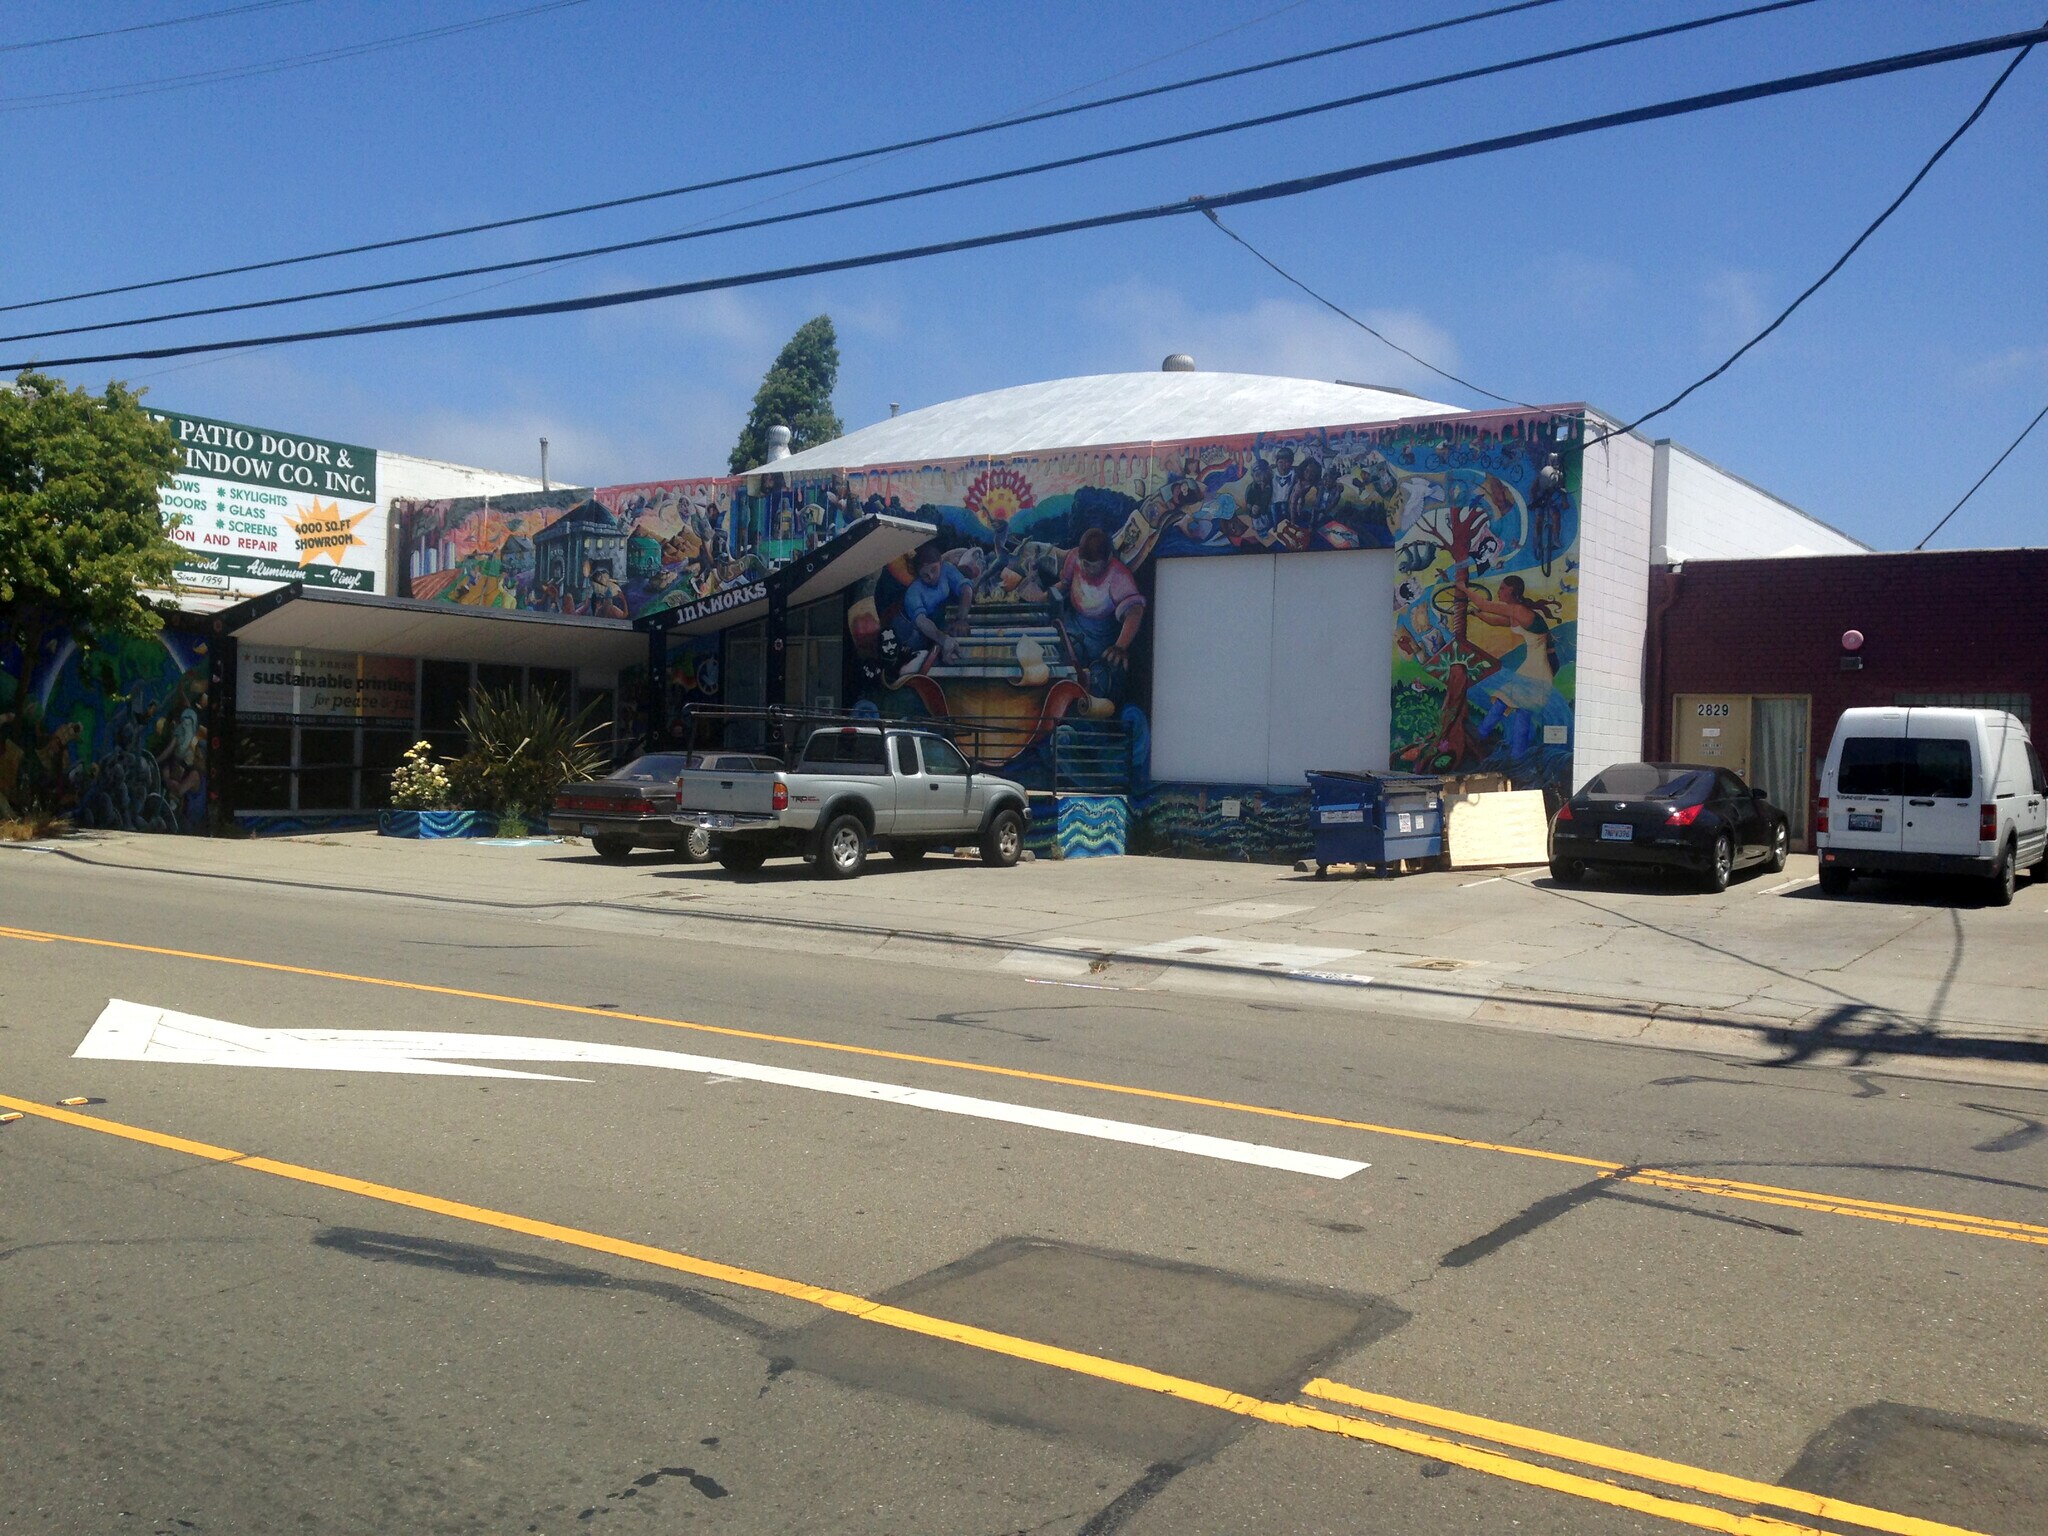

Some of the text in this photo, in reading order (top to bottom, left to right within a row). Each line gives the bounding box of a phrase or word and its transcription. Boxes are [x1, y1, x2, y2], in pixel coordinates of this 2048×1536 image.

[179, 419, 254, 451] PATIO
[259, 434, 331, 465] DOOR
[336, 448, 354, 469] &
[172, 447, 371, 495] INDOW CO. INC.
[164, 494, 207, 511] DOORS
[229, 487, 288, 507] SKYLIGHTS
[229, 504, 266, 519] GLASS
[228, 519, 278, 537] SCREENS
[203, 532, 230, 547] AND
[238, 537, 278, 552] REPAIR
[294, 533, 354, 551] SHOWROOM
[175, 571, 223, 586] Since 1959
[246, 558, 307, 580] Aluminum
[329, 567, 361, 590] Vinyl
[254, 654, 316, 668] INKWORKS
[252, 668, 352, 690] sustainable
[310, 692, 329, 709] for
[331, 694, 378, 712] peace
[1698, 704, 1729, 716] 2829
